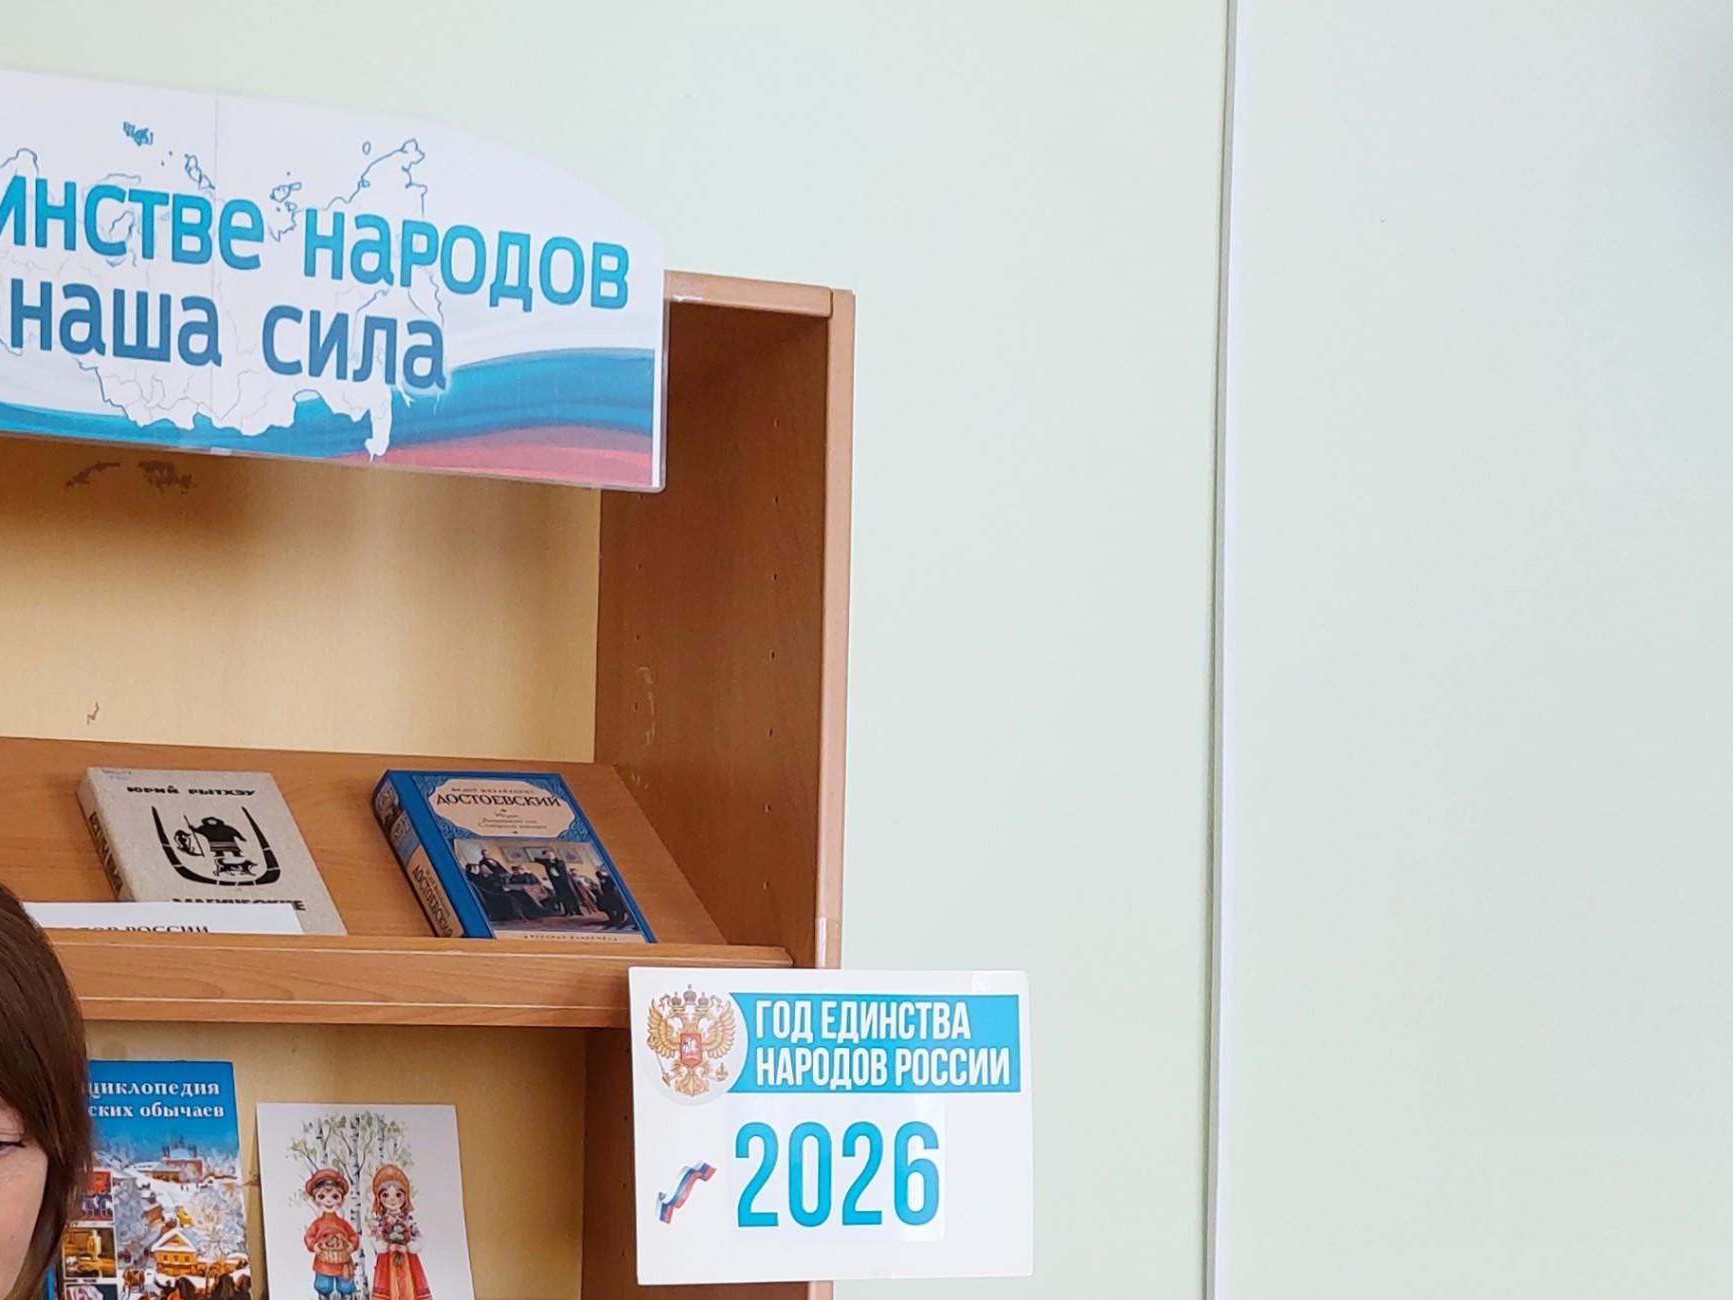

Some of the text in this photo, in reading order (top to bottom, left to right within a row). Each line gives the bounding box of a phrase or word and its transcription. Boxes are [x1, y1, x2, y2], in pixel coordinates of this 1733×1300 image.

[303, 208, 631, 312] народов
[11, 277, 447, 389] наша сила
[126, 785, 256, 796] ЮРИЙ РЫТХЭУ
[437, 794, 561, 807] ДОСТОЕВСКИЙ
[755, 999, 971, 1044] ГОД ЕДИНСТВА
[755, 1046, 1011, 1090] НАРОДОВ РОССИИ
[88, 1082, 220, 1099] циклопедия
[88, 1101, 224, 1117] ских обычаев
[735, 1120, 940, 1228] 2026
